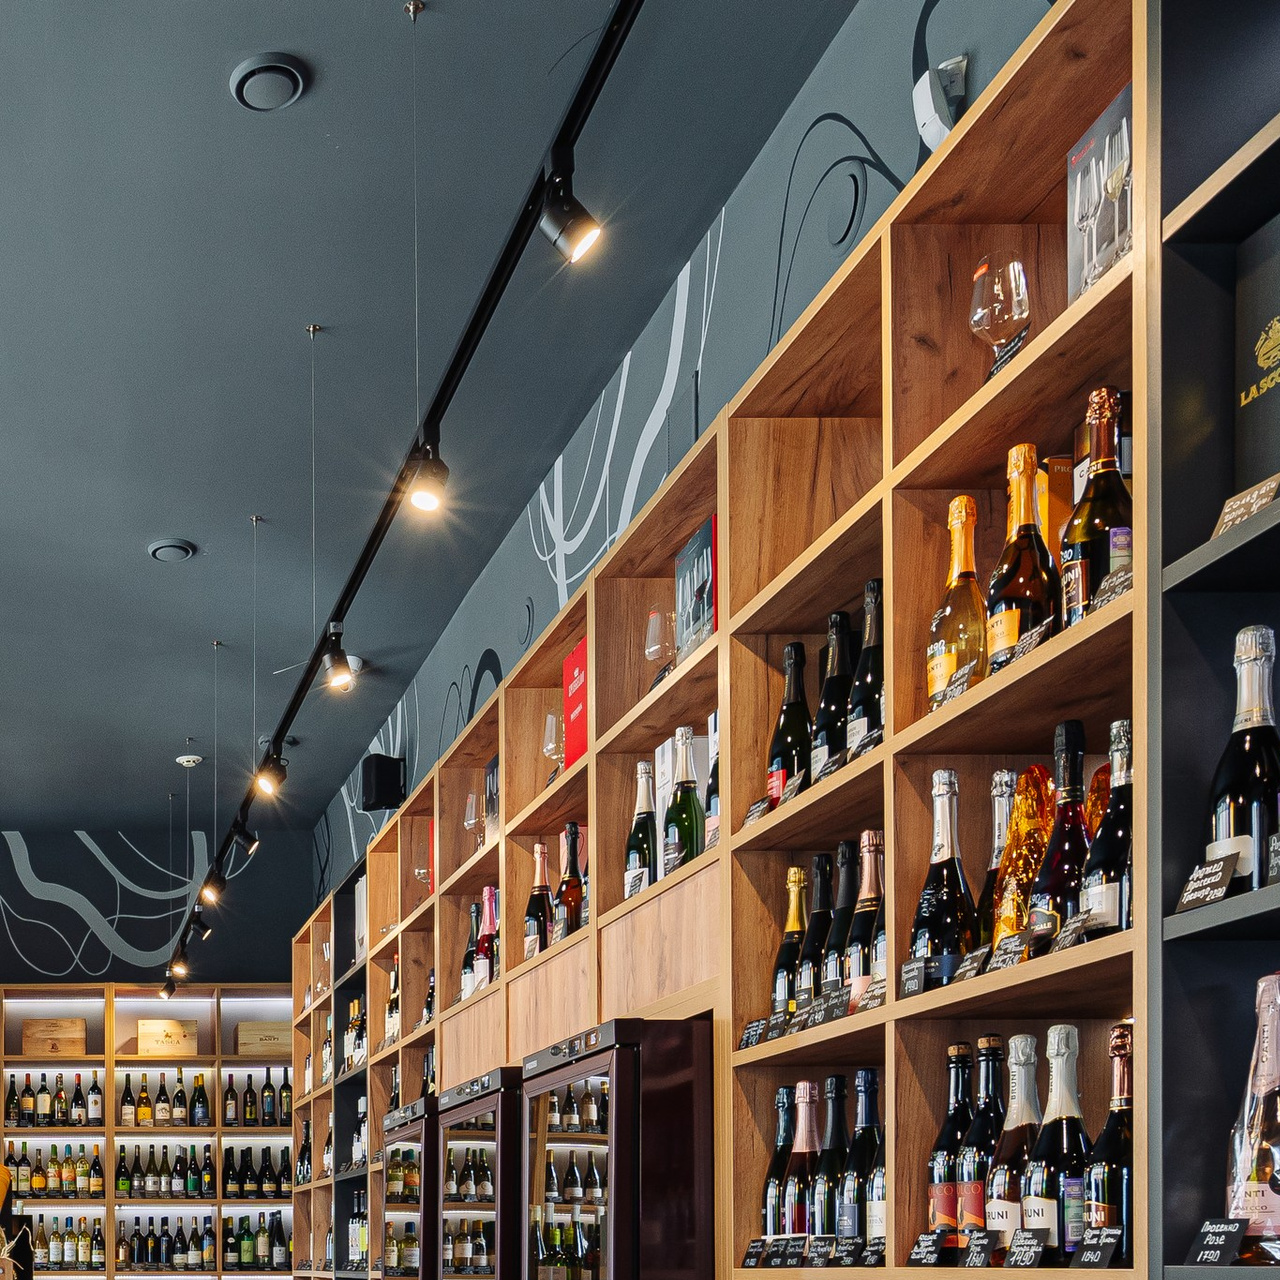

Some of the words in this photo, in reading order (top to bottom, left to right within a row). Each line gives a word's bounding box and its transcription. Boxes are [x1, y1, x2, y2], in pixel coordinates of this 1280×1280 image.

[1062, 567, 1080, 587] UNI
[987, 619, 1003, 632] ANTI
[987, 1210, 1009, 1220] RUNI
[1025, 1208, 1044, 1218] RUNI
[1083, 1211, 1105, 1222] RUNI
